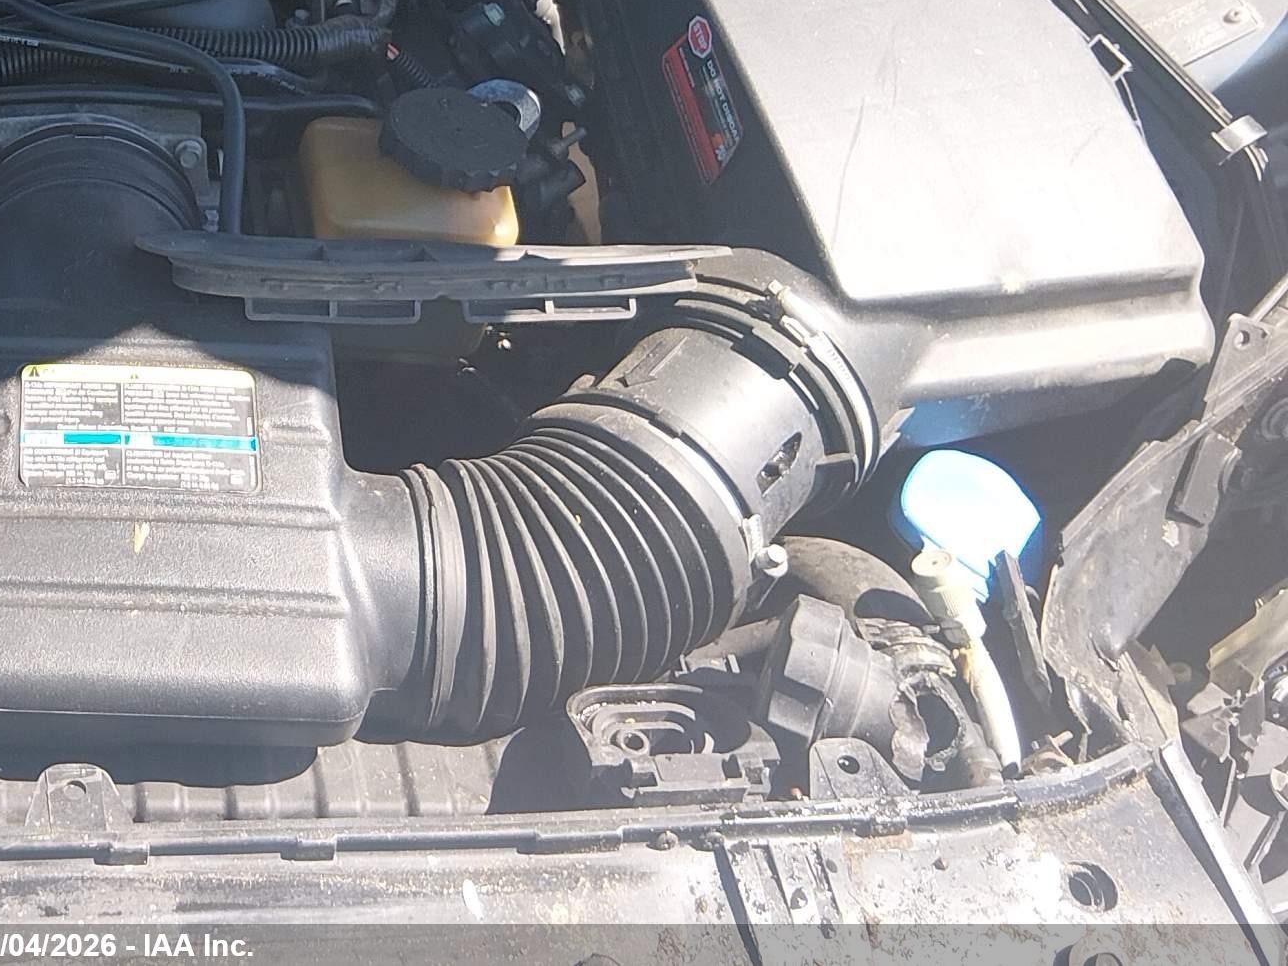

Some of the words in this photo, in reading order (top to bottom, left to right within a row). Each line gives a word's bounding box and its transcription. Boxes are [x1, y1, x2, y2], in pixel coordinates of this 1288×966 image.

[693, 21, 708, 50] STOP
[706, 59, 716, 78] DO
[713, 80, 725, 100] NOT
